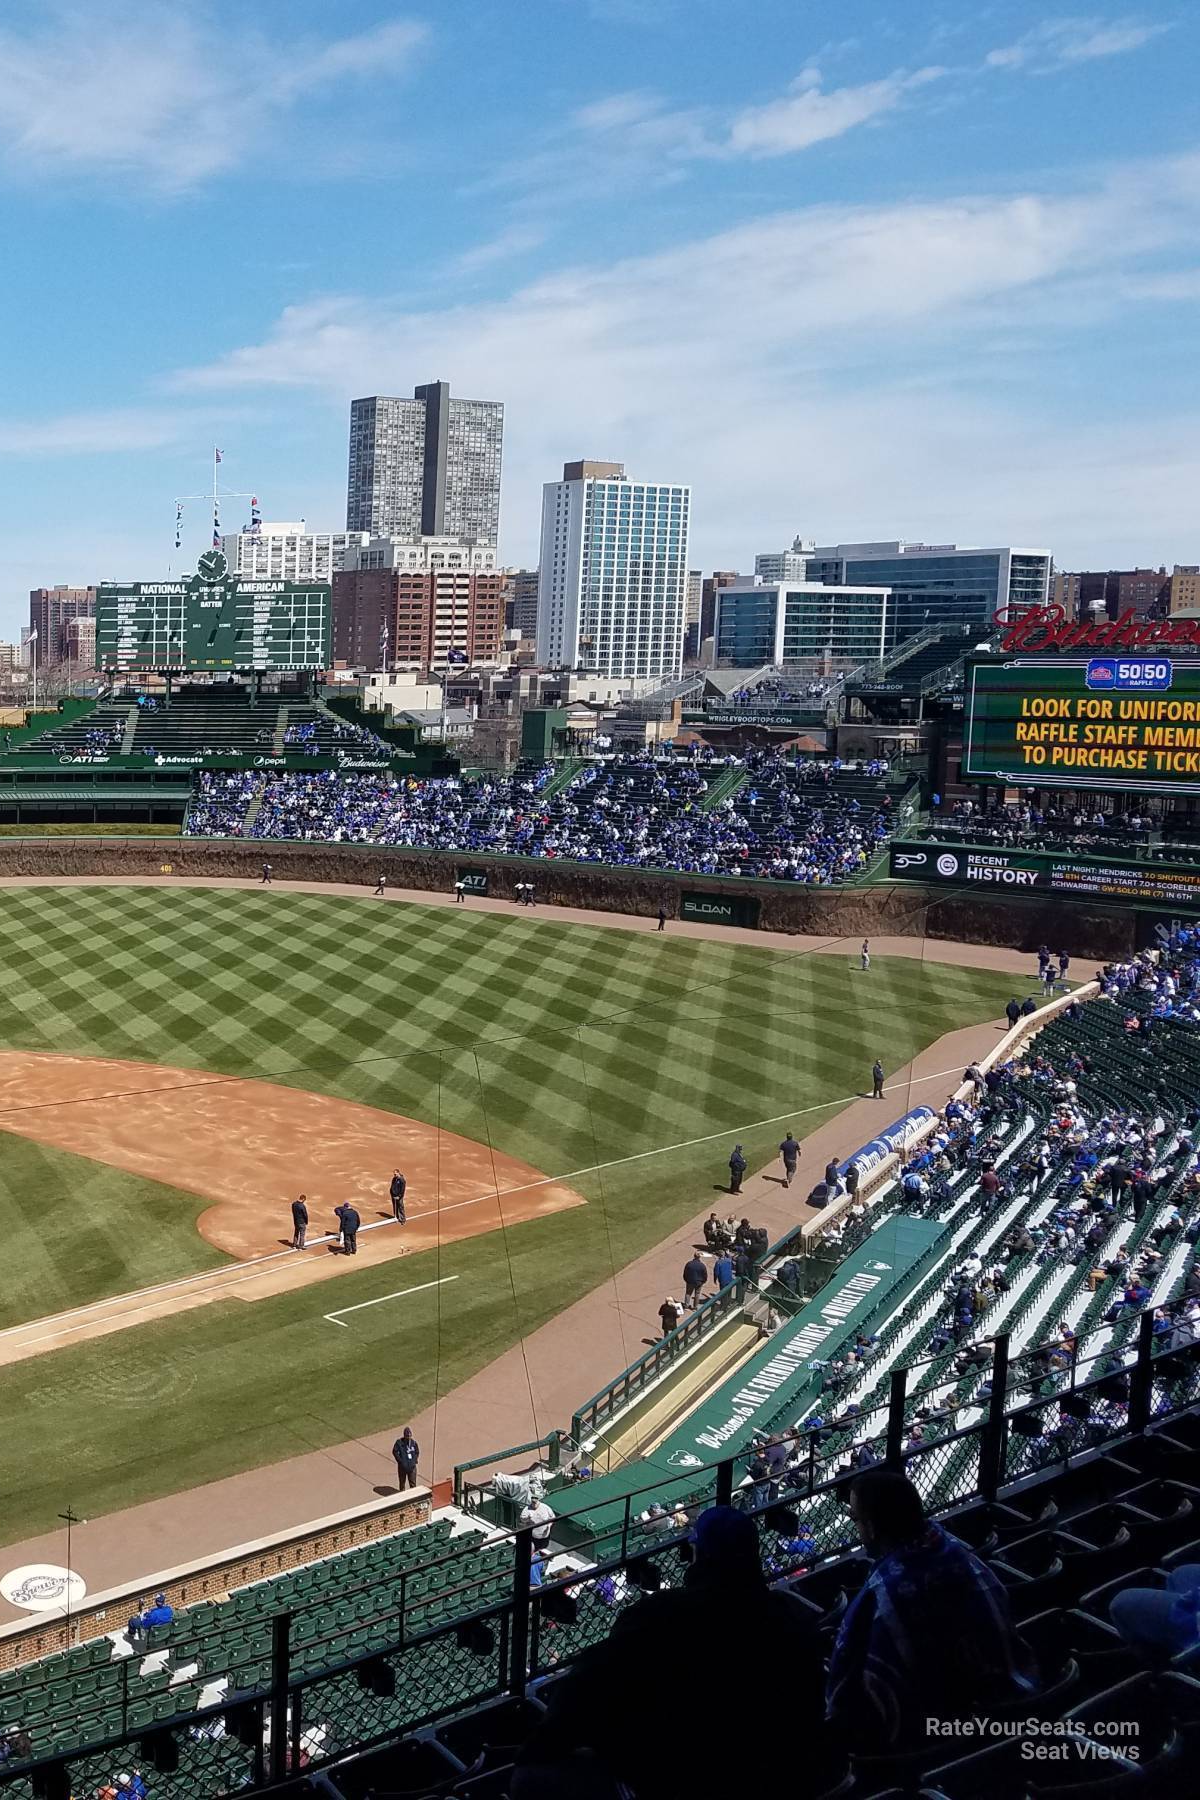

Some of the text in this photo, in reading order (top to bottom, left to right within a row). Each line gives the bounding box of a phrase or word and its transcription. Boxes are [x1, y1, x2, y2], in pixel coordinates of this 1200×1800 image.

[140, 584, 188, 594] NATIONAL
[236, 582, 284, 592] AMERICAN
[1022, 698, 1200, 721] LOOK FOR UNIFOR
[708, 715, 792, 724] WRIGLEYROOFTOPS.COM
[1016, 722, 1079, 742] RAFFLE
[1084, 725, 1138, 745] STAFF
[166, 756, 203, 764] Advocate
[264, 756, 286, 766] pepsi
[338, 756, 391, 768] Budweiser
[1023, 746, 1046, 764] TO
[1052, 747, 1148, 769] PURCHASE
[968, 855, 1009, 866] RECENT
[461, 875, 487, 886] ATI
[967, 867, 1038, 885] HISTORY
[1081, 875, 1112, 884] CAREER
[1099, 869, 1143, 878] HENDRICKS
[1157, 874, 1195, 883] SHUTOUT
[684, 902, 731, 915] SLOAN
[782, 1322, 834, 1358] CONFINES
[747, 1354, 802, 1392] FRIENDLY
[731, 1388, 770, 1407] THE
[732, 1407, 755, 1416] to
[695, 1415, 748, 1448] Welcome
